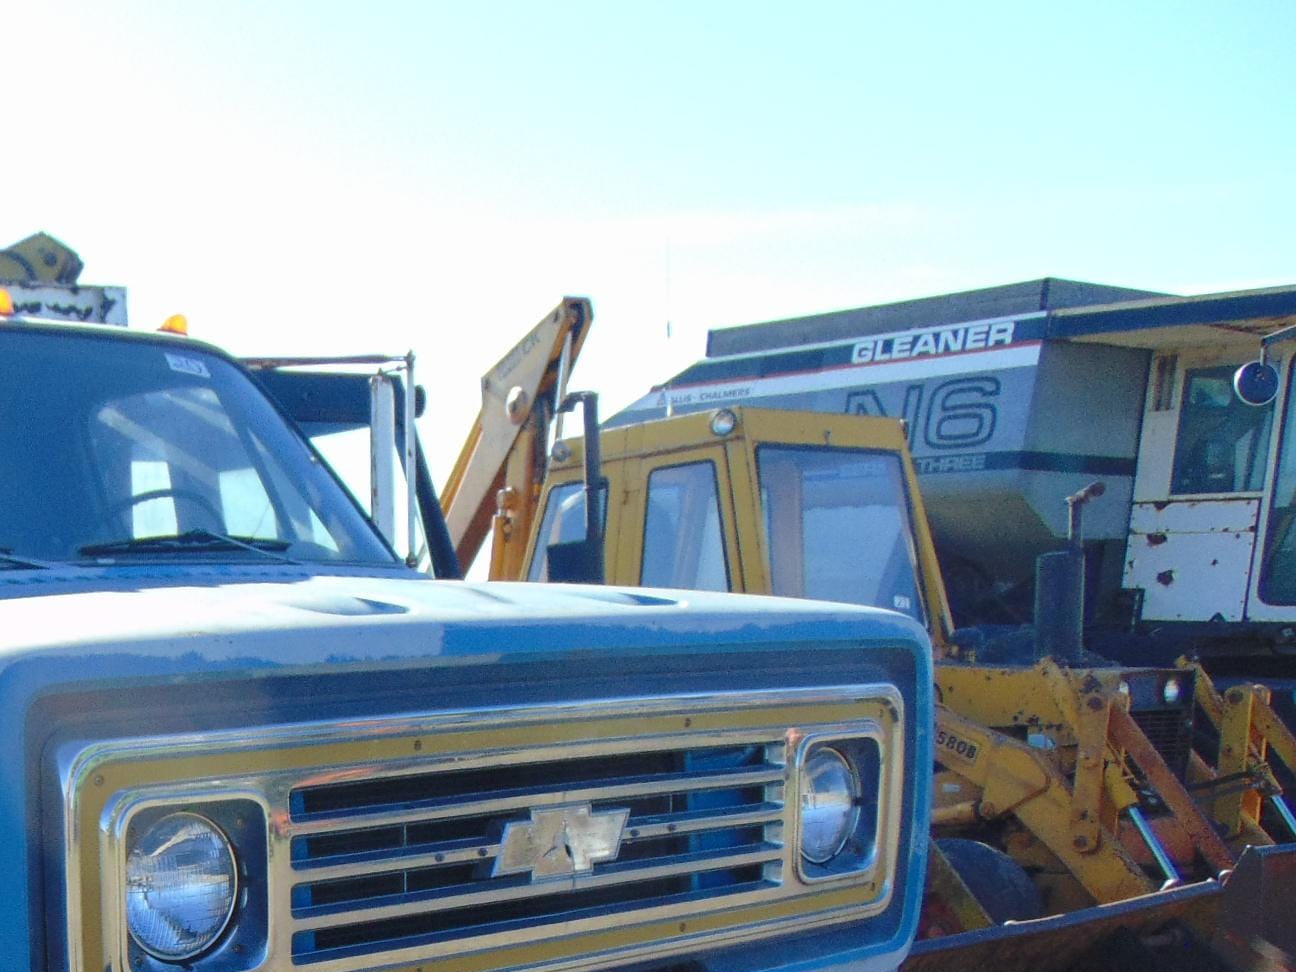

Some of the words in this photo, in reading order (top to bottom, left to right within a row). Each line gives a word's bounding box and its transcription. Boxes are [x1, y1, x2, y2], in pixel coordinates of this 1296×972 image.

[851, 322, 1014, 364] GLEANER
[917, 455, 986, 475] THREE
[936, 731, 976, 758] 580B
